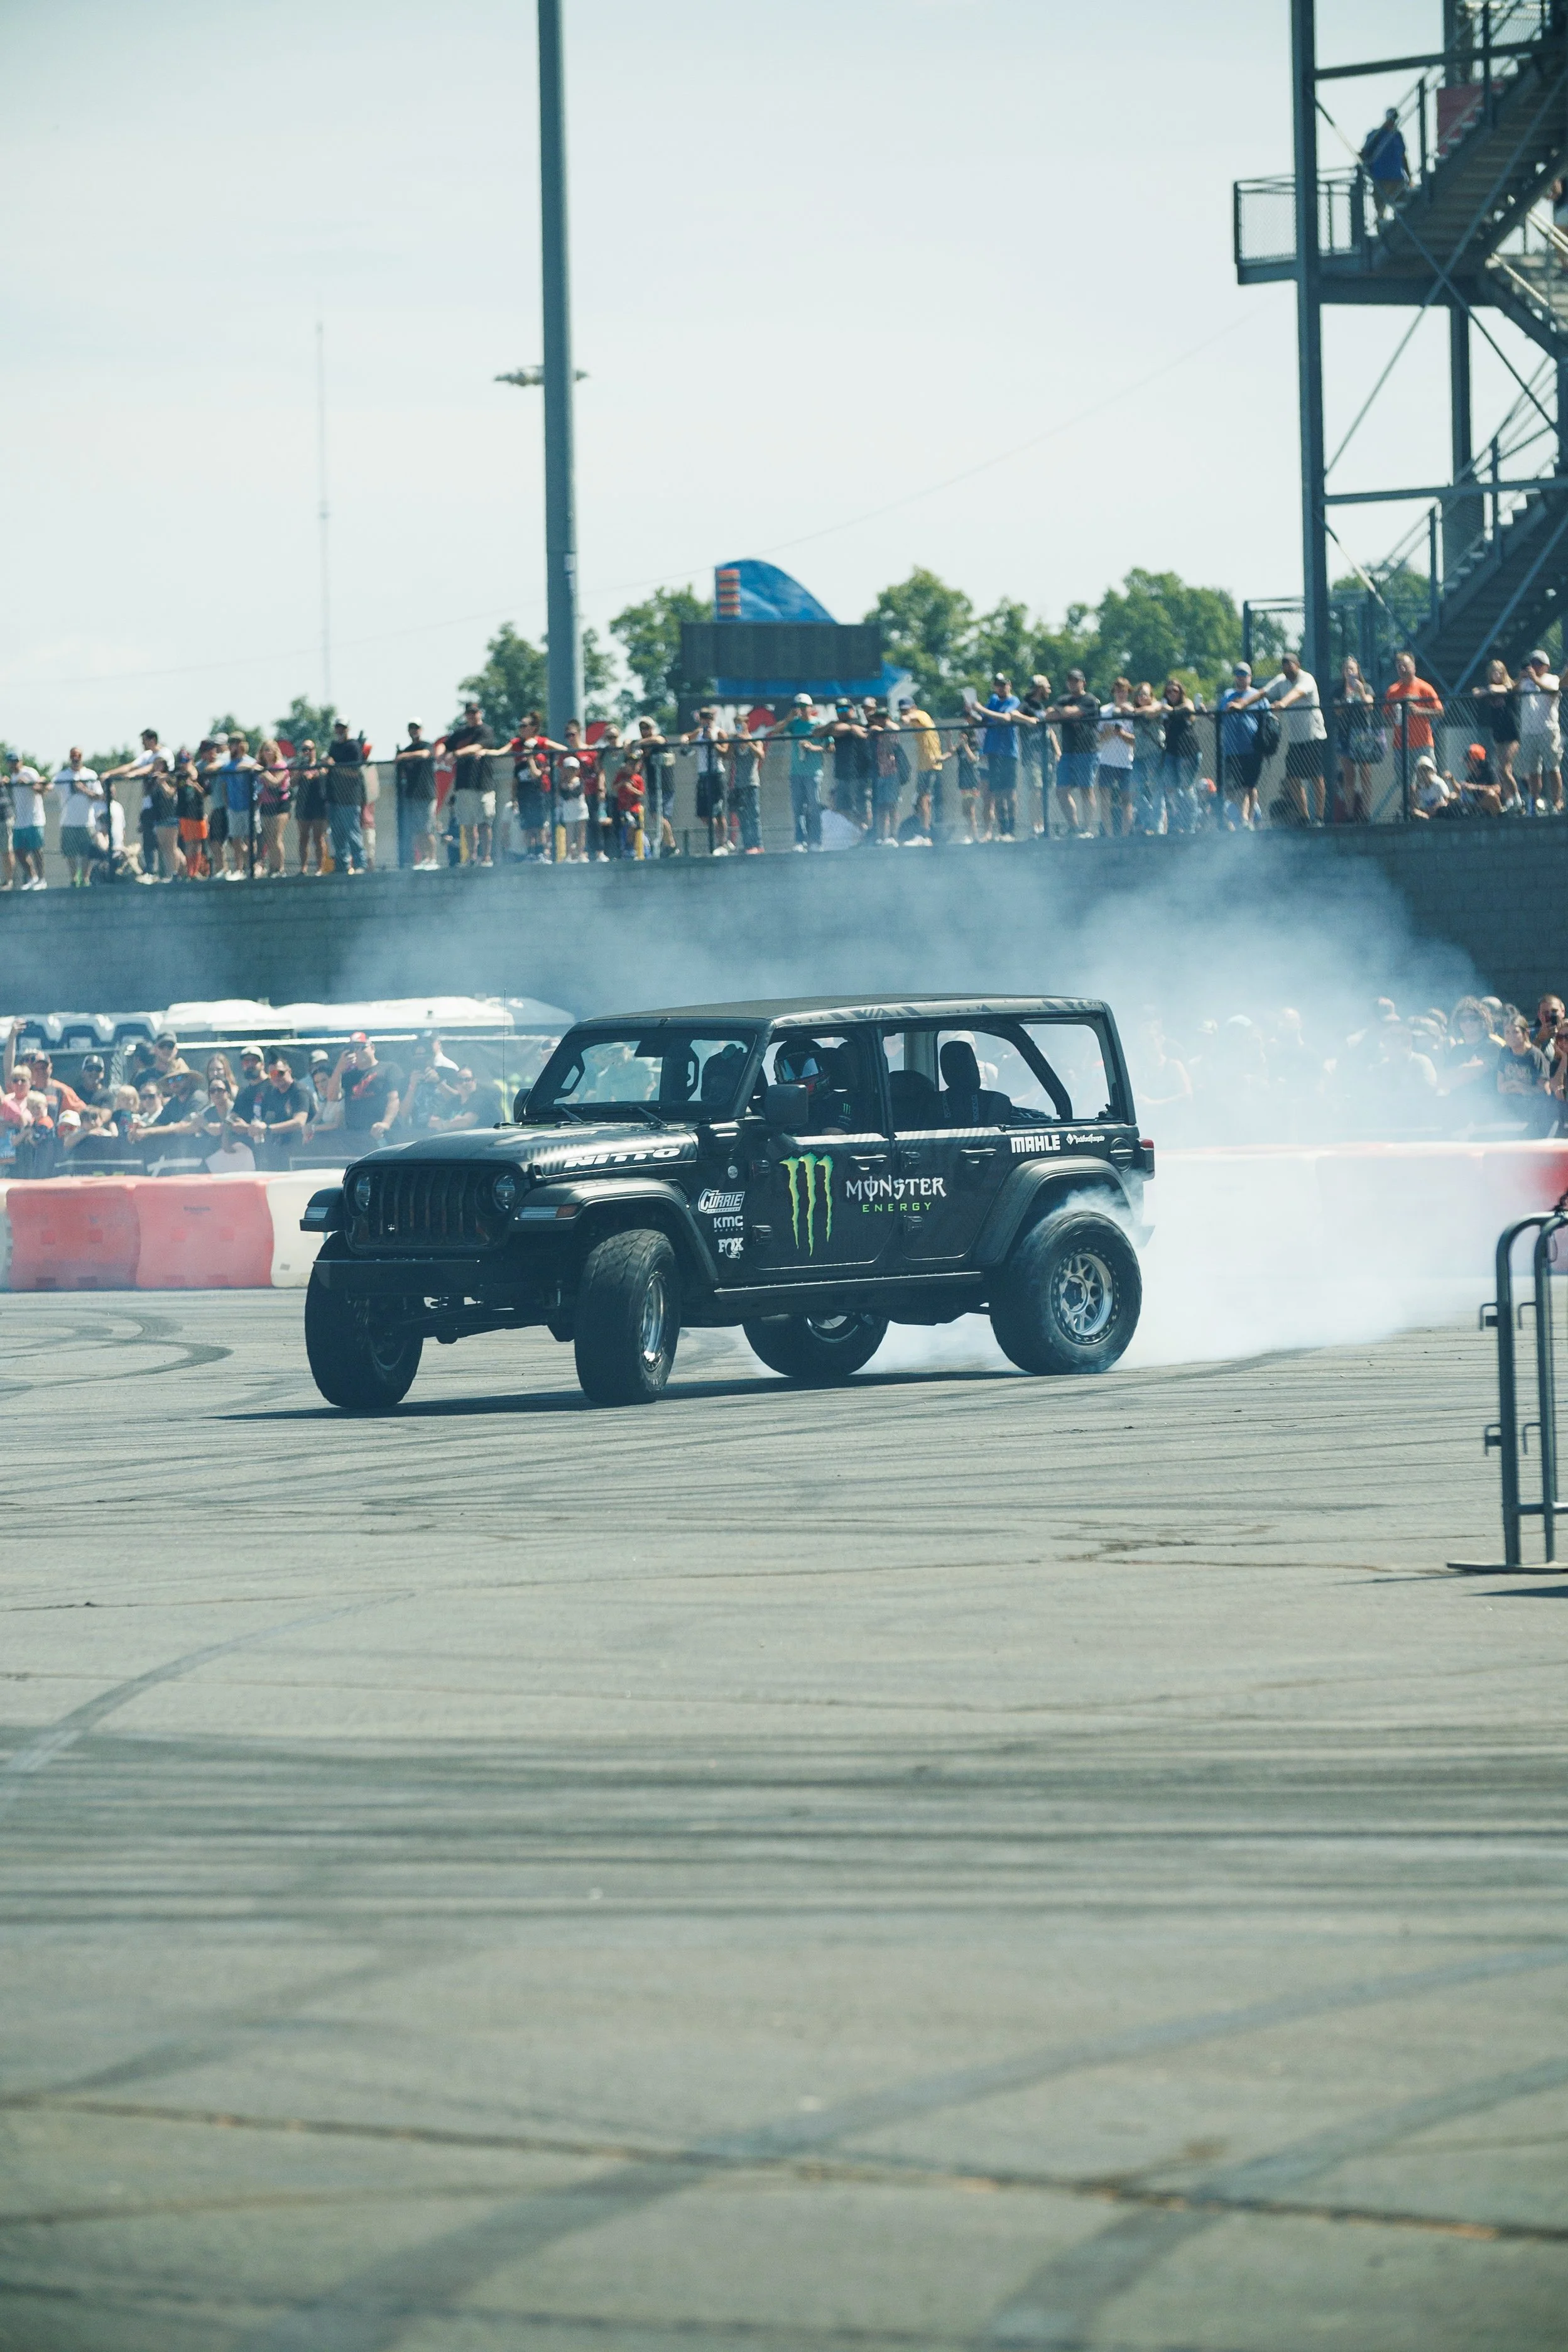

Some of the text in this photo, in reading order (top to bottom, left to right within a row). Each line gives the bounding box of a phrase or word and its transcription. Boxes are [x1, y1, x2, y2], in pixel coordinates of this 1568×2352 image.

[1010, 1135, 1061, 1153] MAHLE
[564, 1148, 681, 1168] NITTO
[846, 1175, 947, 1201] MONSTER
[699, 1190, 743, 1211] CURRIE
[862, 1202, 932, 1212] ENERGY
[713, 1215, 744, 1229] KMC
[718, 1237, 744, 1258] FOX
